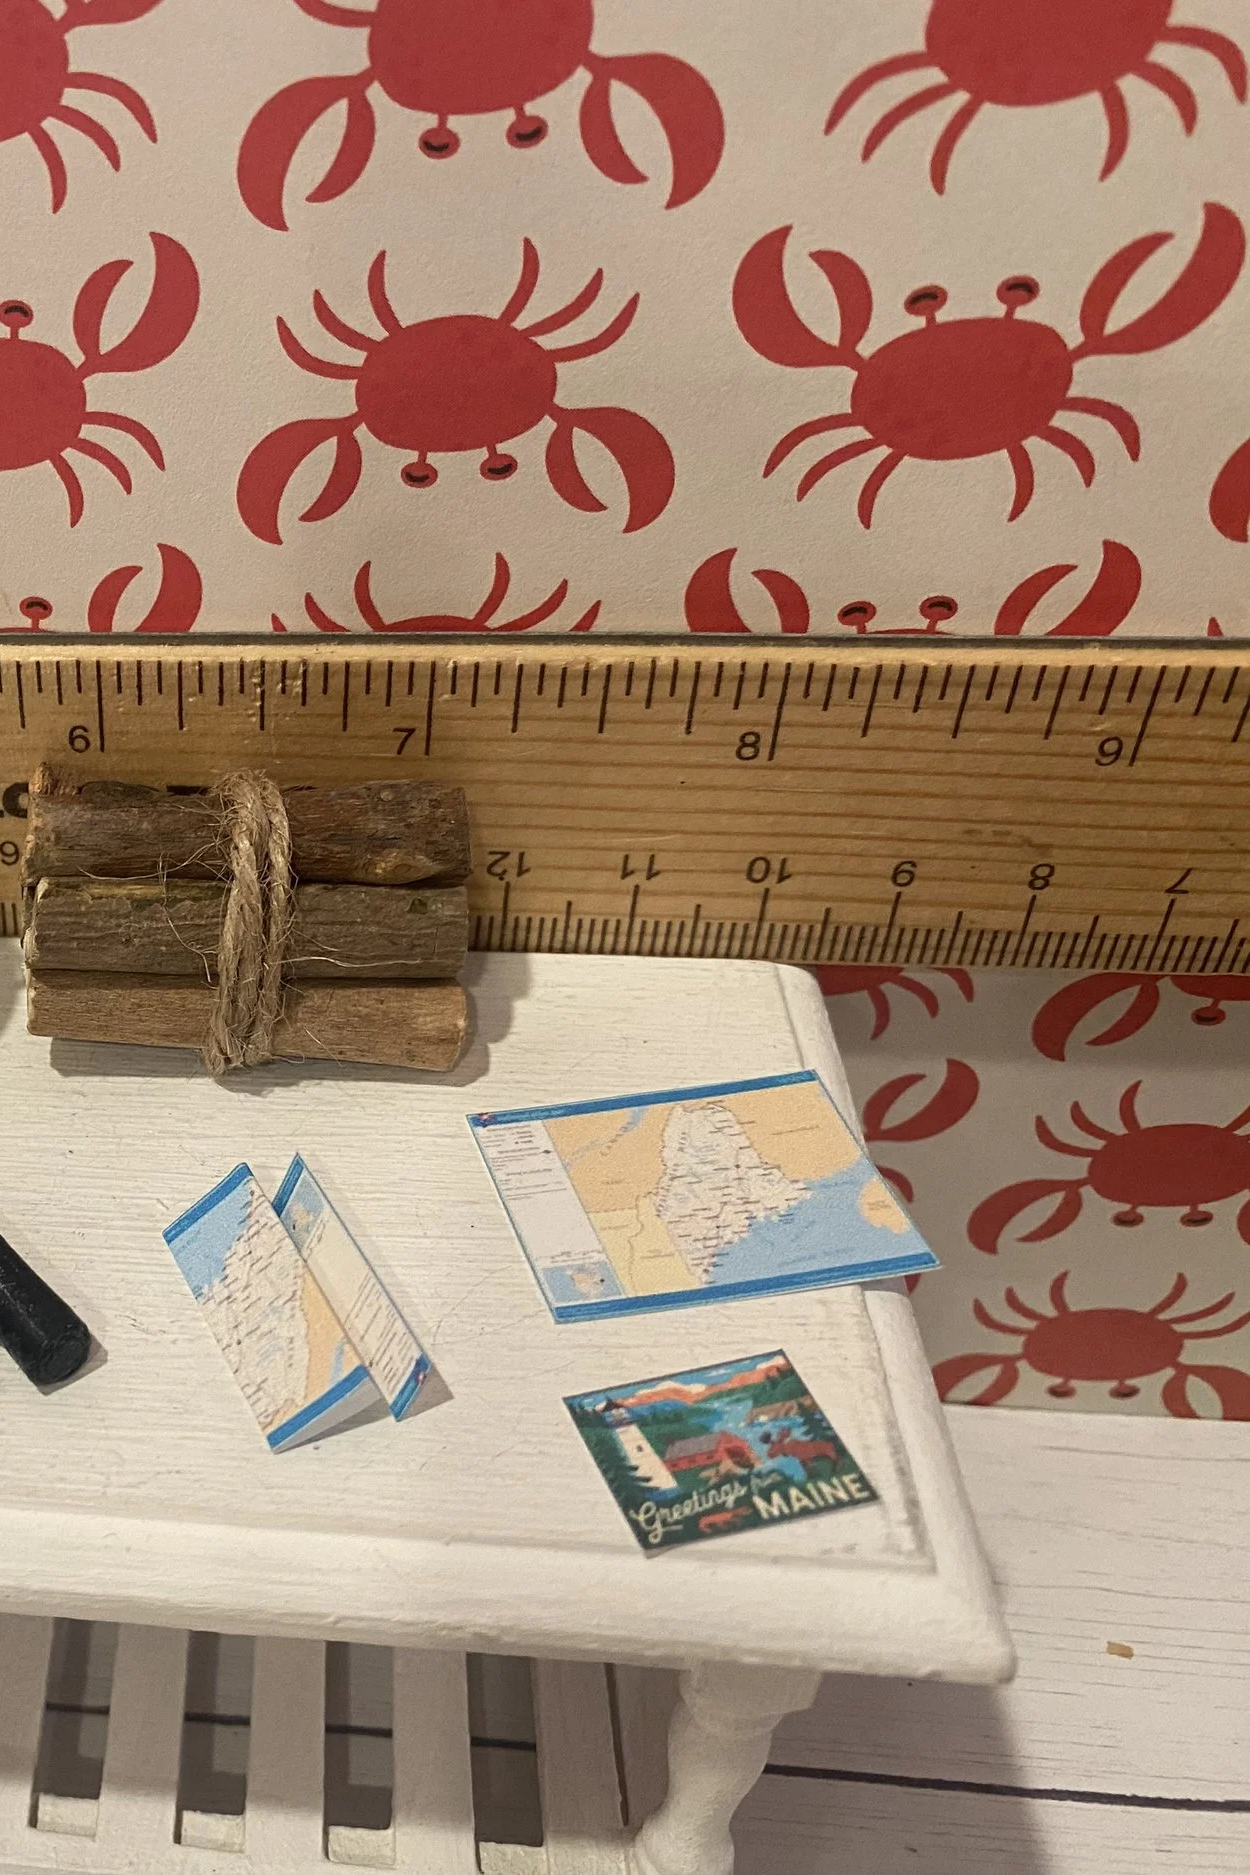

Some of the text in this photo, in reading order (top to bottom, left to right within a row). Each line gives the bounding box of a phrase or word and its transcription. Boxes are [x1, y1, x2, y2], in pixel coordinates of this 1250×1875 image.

[69, 726, 90, 753] 6
[393, 728, 416, 755] 7
[736, 732, 760, 760] 8
[1096, 736, 1123, 766] 9
[486, 850, 530, 880] 12
[620, 854, 661, 880] 11
[746, 856, 792, 884] 10
[1028, 863, 1055, 891] 8
[1164, 867, 1193, 894] 7
[752, 1473, 869, 1519] MAINE
[630, 1480, 748, 1544] Greetings
